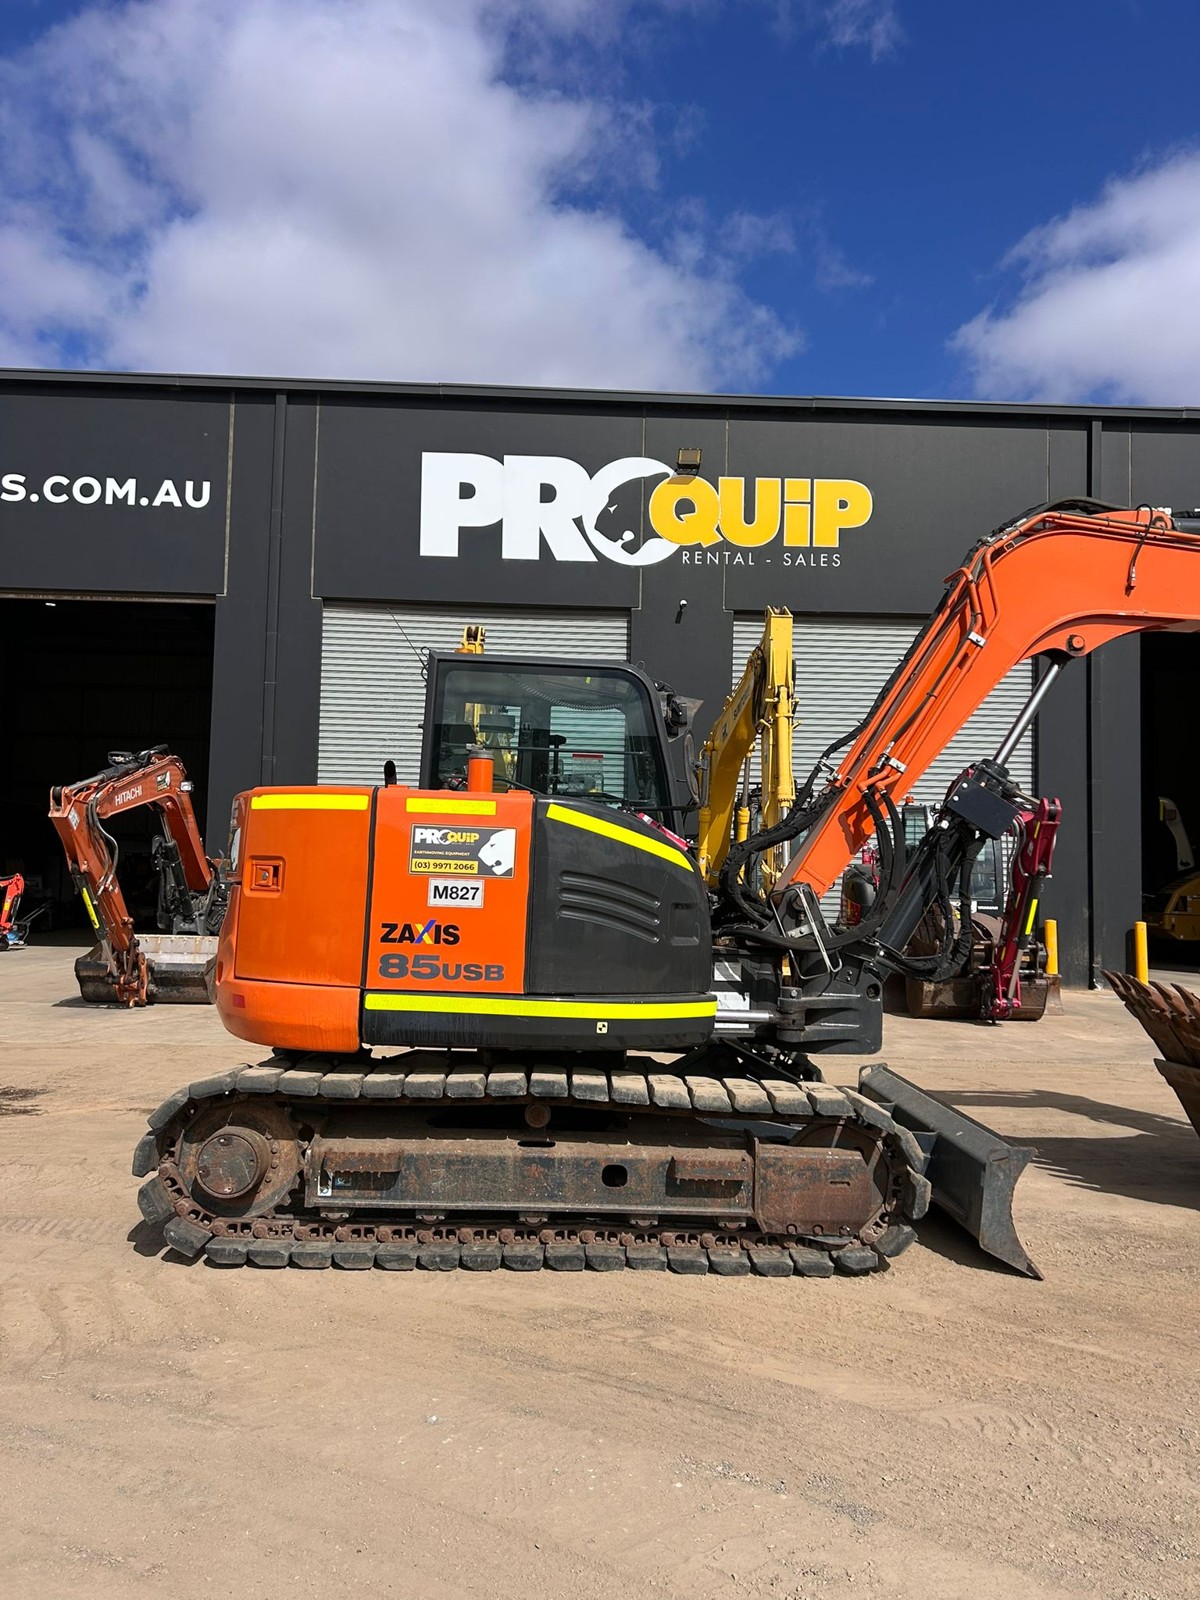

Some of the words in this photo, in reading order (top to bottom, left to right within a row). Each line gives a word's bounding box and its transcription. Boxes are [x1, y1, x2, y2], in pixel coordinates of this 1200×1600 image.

[0, 473, 211, 509] S.COM.AU
[682, 551, 755, 565] RENTAL
[783, 552, 841, 567] SALES
[115, 785, 143, 806] HITACHI
[414, 861, 431, 870] (03)
[433, 862, 452, 870] 9971
[454, 863, 475, 871] 2066
[433, 885, 480, 901] M827
[380, 919, 460, 945] ZAXIS
